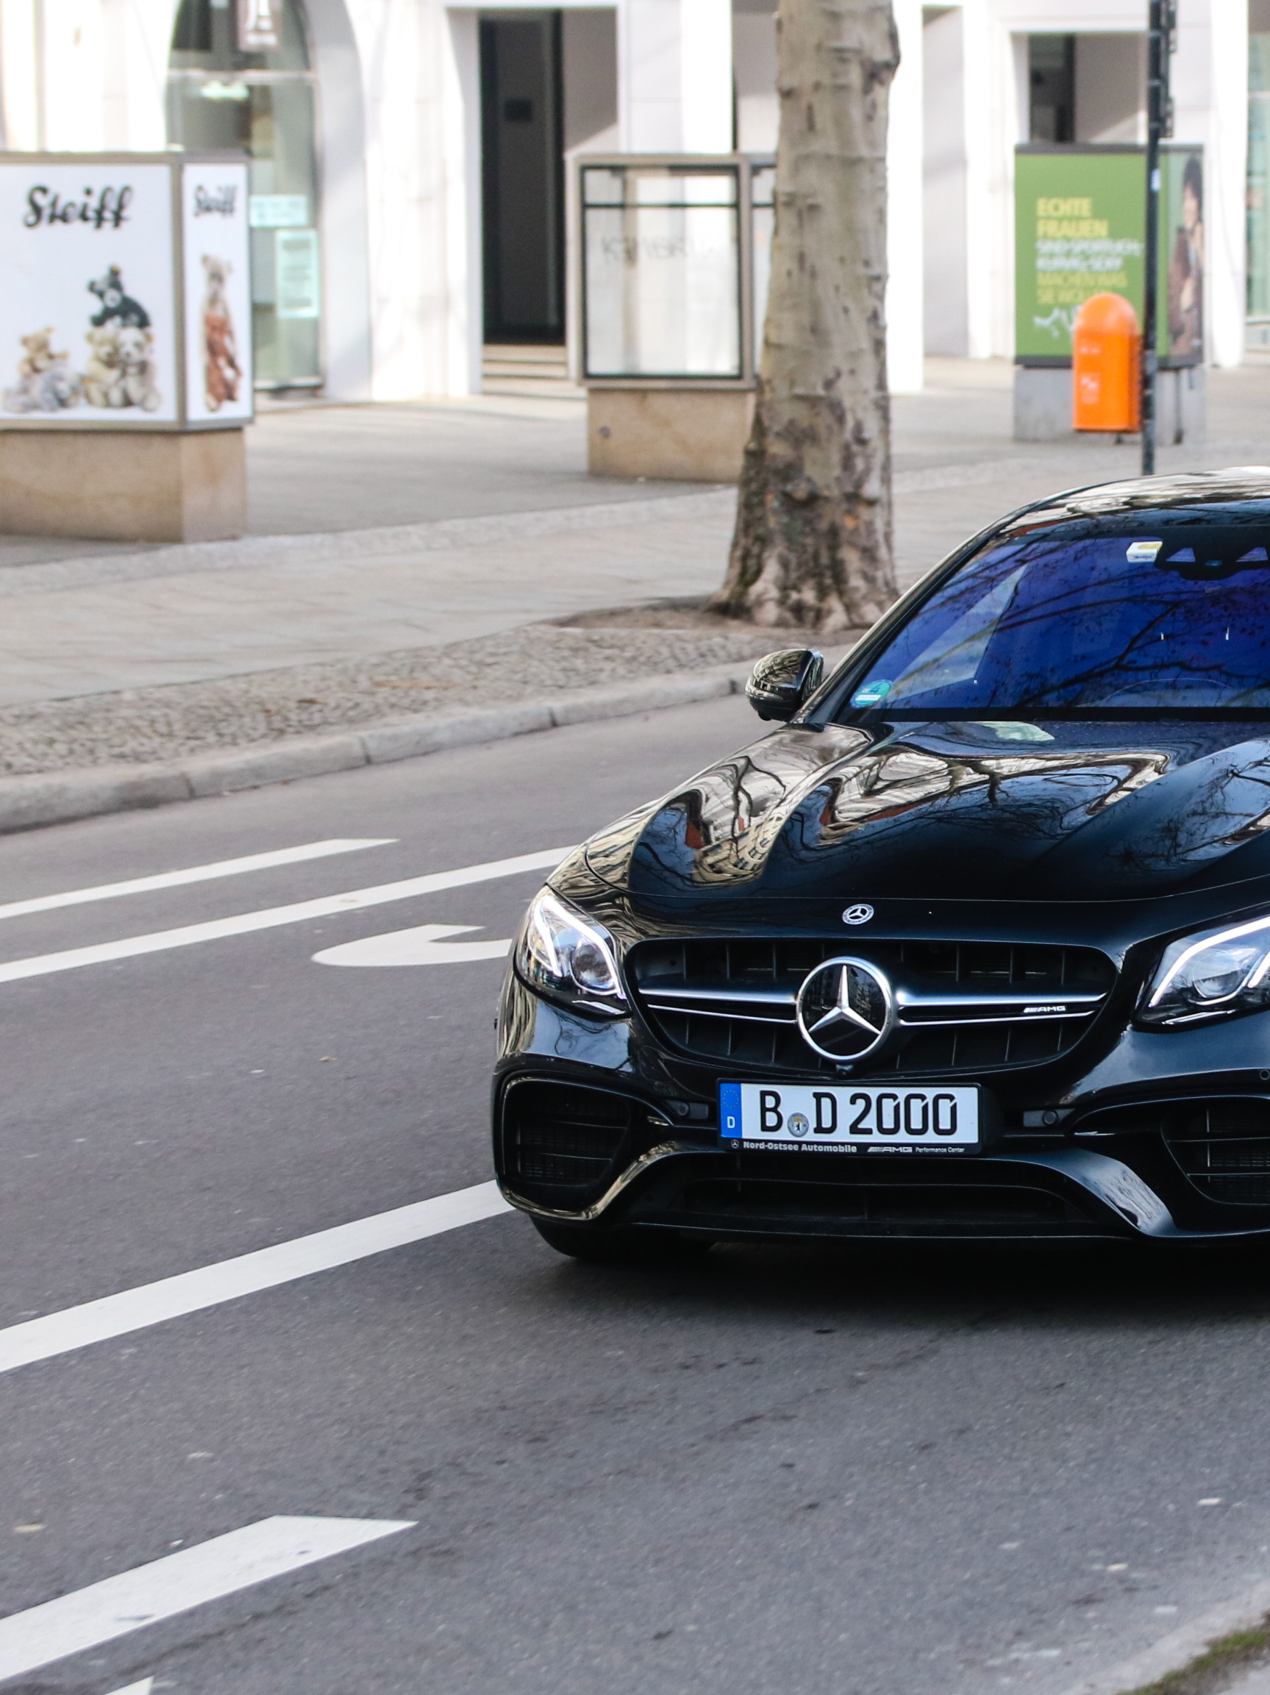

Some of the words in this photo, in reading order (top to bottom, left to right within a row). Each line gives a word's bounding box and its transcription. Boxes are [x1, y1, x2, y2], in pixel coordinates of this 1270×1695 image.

[23, 185, 133, 230] Steiff
[1037, 198, 1092, 217] ECHTE
[1037, 219, 1109, 237] FRAUEN
[759, 1090, 783, 1132] B
[813, 1092, 837, 1134] D
[849, 1092, 958, 1135] 2000
[726, 1116, 736, 1128] D
[743, 1141, 799, 1151] Nord-Ostsee
[801, 1143, 857, 1153] Automobile
